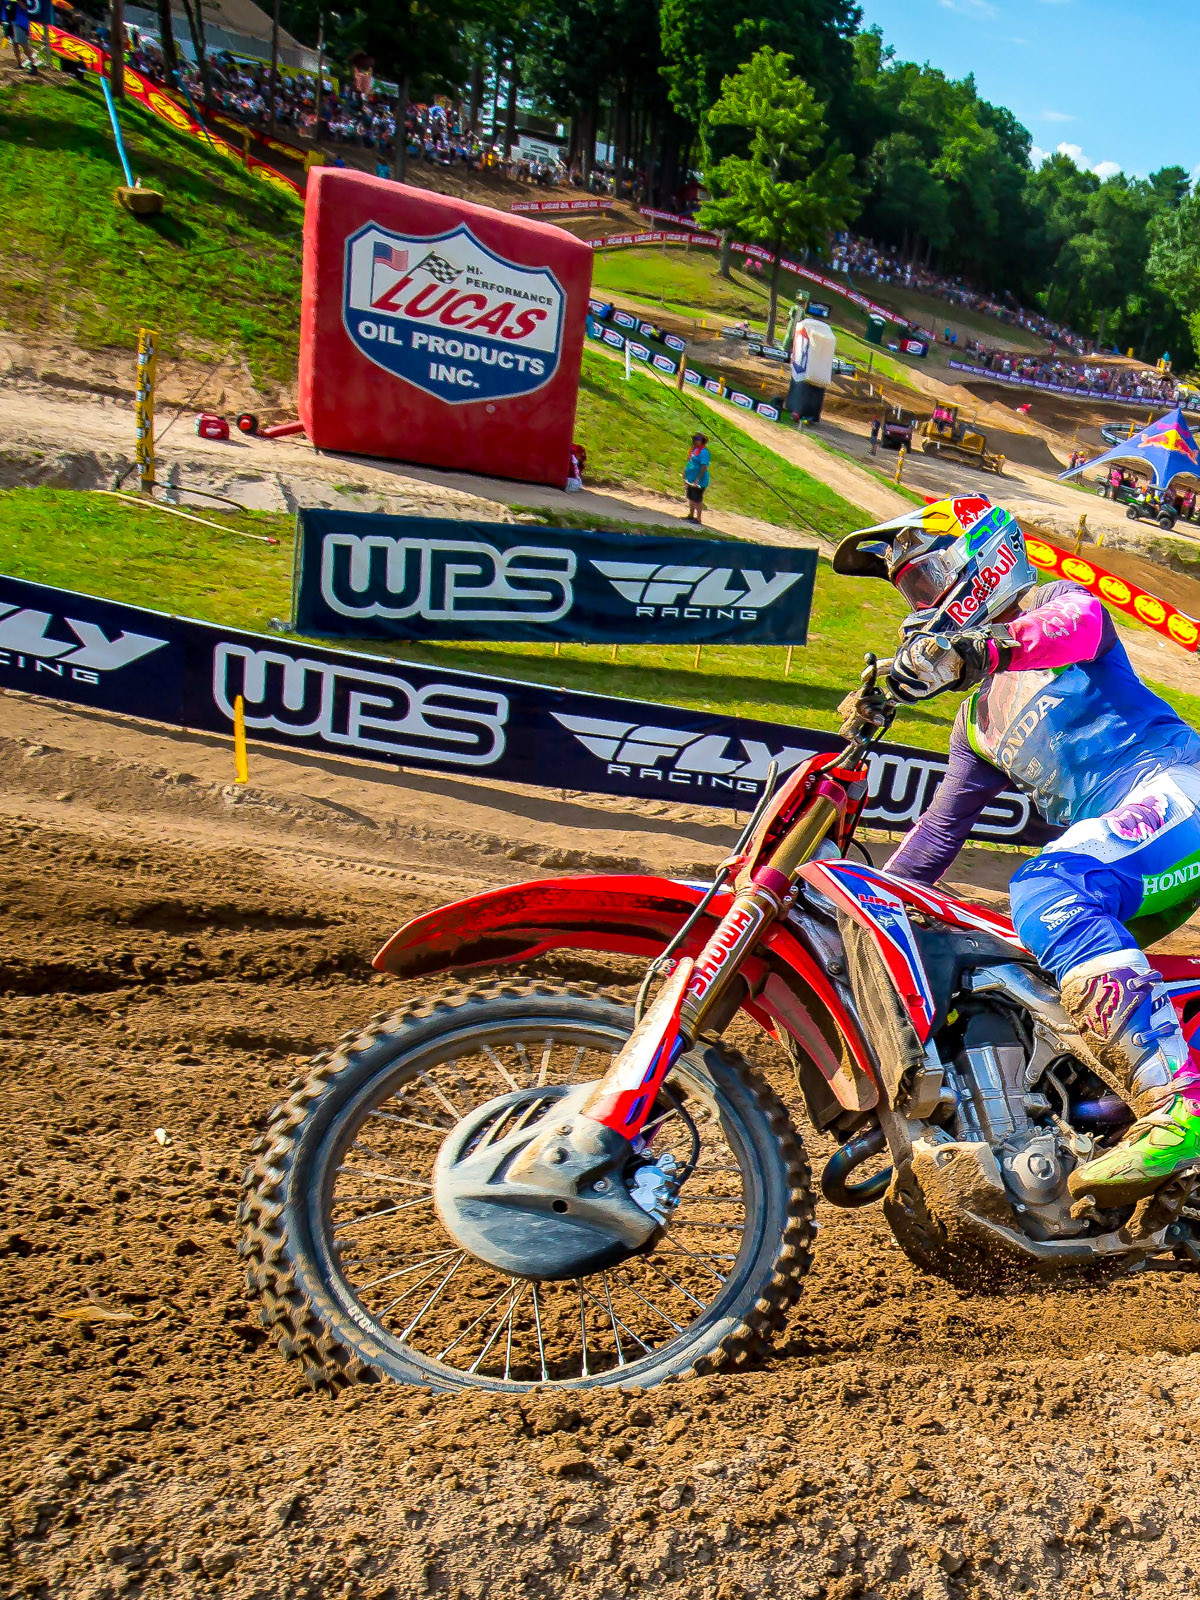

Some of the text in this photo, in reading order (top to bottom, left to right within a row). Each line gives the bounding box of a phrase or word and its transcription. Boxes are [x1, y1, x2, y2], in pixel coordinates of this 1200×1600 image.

[466, 264, 484, 275] HI-
[466, 276, 553, 306] PERFORMANCE
[370, 276, 548, 340] LUCAS
[357, 320, 546, 376] OIL PRODUCTS
[429, 362, 481, 389] INC.
[321, 532, 804, 622] WPS FLY
[945, 543, 1018, 626] Red Bull
[0, 602, 170, 671] LY
[636, 605, 758, 621] RACING
[0, 651, 99, 685] ING
[213, 641, 510, 766] WPS
[549, 711, 819, 780] FLY
[1001, 694, 1065, 778] ONDA
[607, 762, 757, 793] RACING
[1047, 905, 1085, 932] HONDA
[686, 907, 754, 1001] SHOWA
